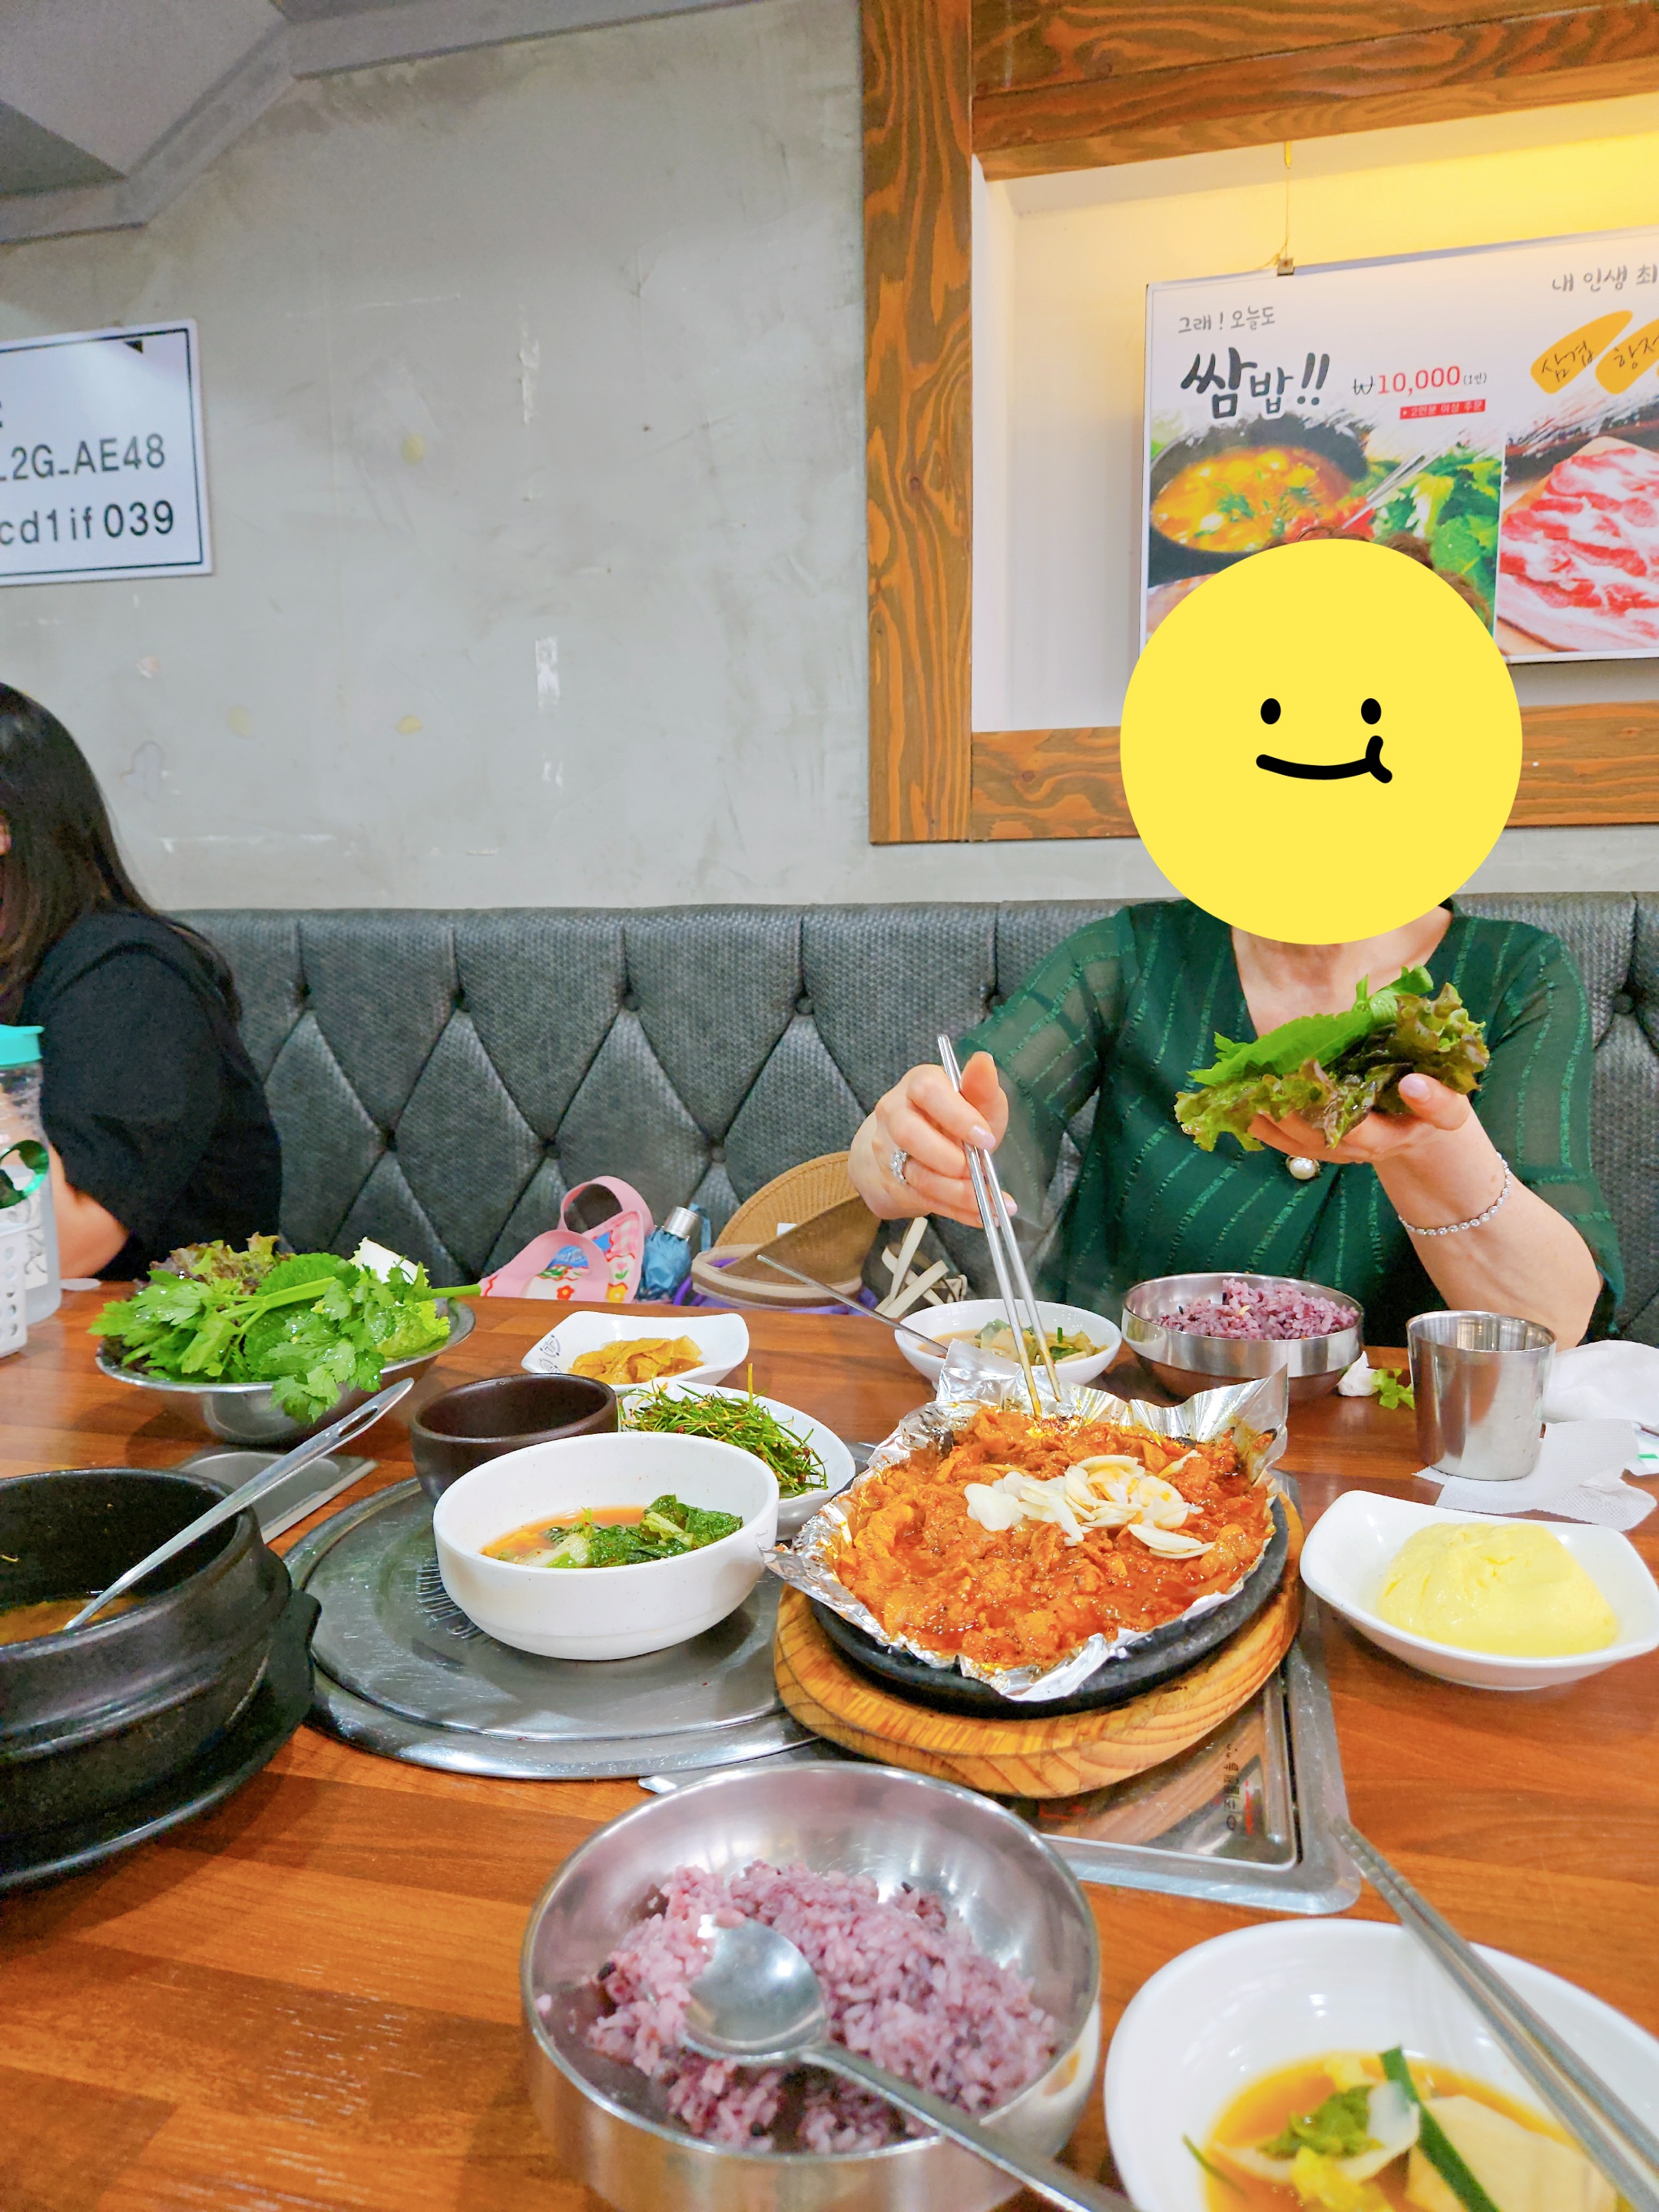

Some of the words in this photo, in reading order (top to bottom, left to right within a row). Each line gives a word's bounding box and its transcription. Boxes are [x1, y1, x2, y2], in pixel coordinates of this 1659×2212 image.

[1552, 273, 1574, 292] 내
[1583, 264, 1628, 292] 인생
[1636, 263, 1658, 286] 최
[1230, 306, 1275, 330] 오늘도
[1541, 339, 1594, 382] 삼겹
[1181, 347, 1330, 419] 쌈밥!!
